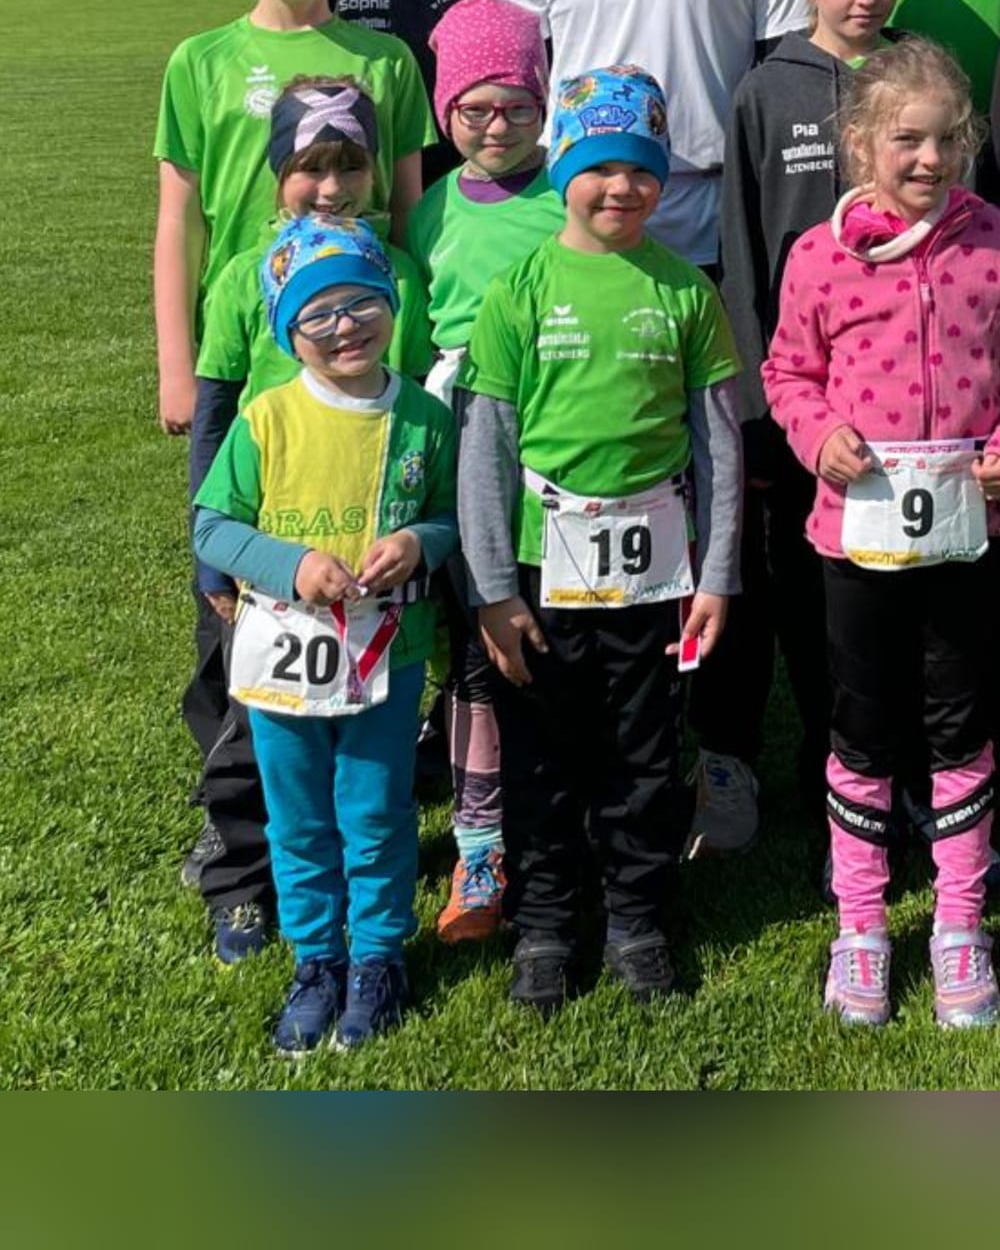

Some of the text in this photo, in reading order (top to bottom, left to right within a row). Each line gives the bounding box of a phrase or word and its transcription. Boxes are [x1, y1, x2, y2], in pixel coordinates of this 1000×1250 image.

[902, 488, 934, 538] 9
[589, 524, 652, 578] 19
[271, 631, 340, 686] 20
